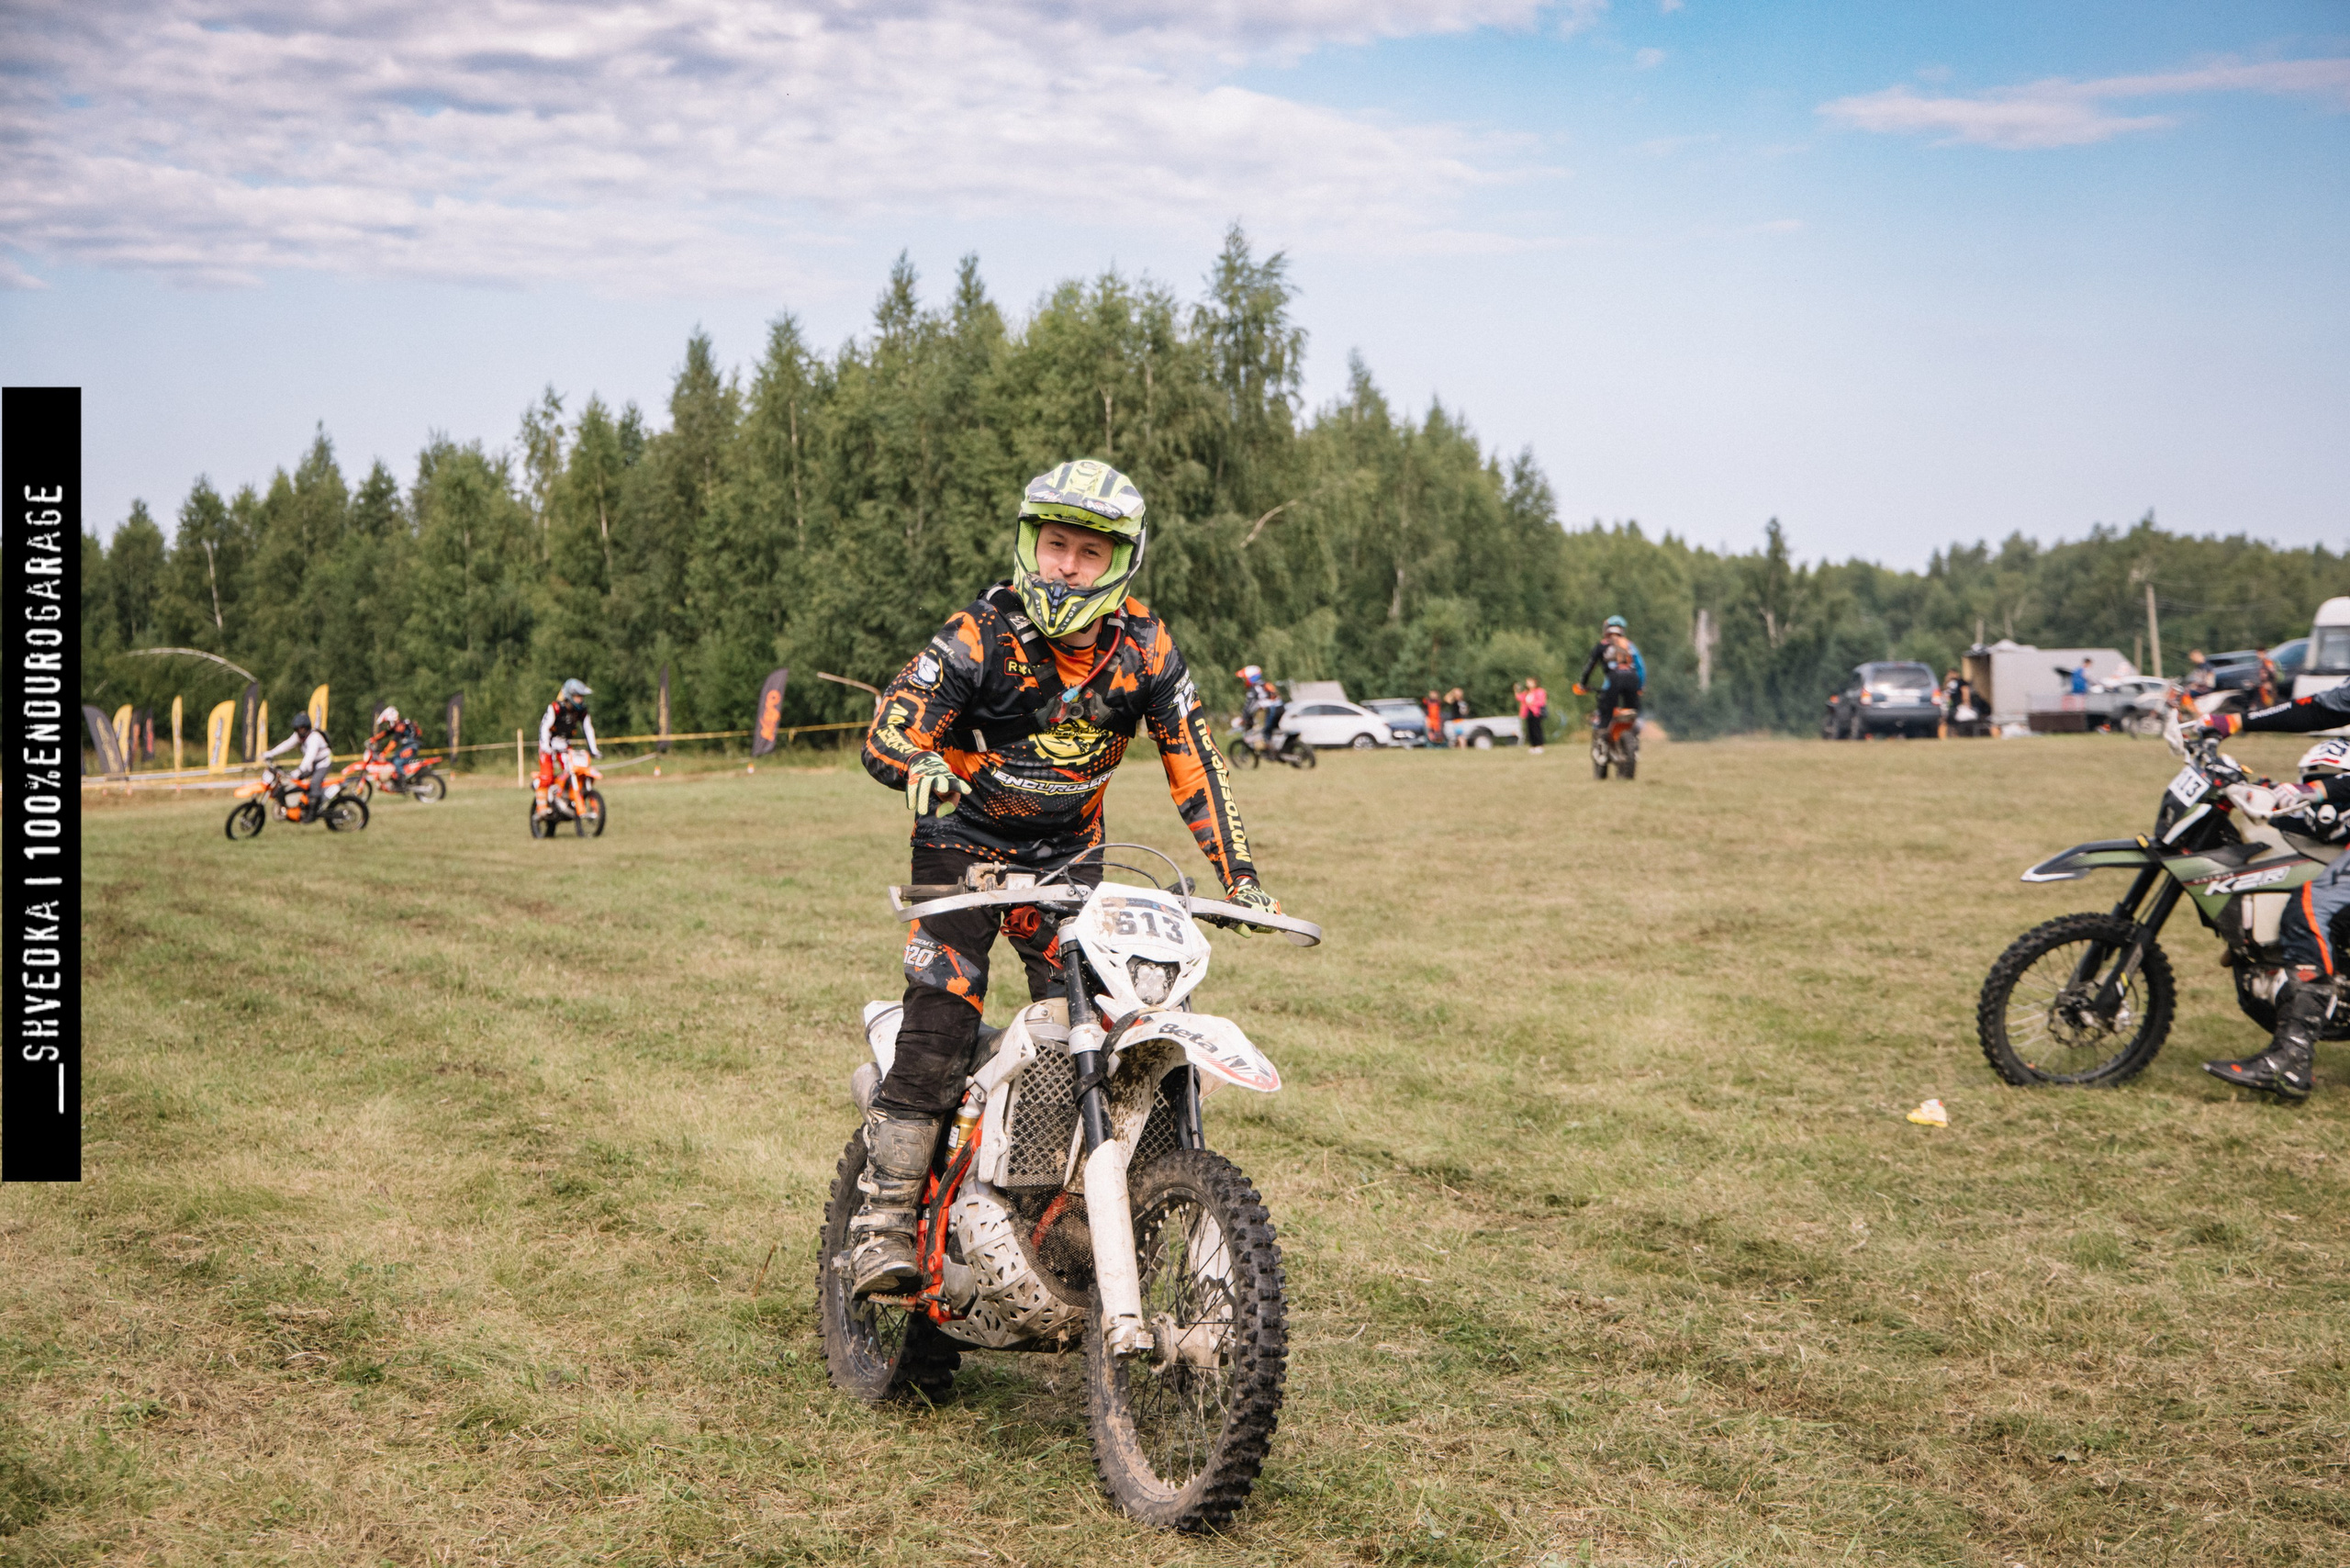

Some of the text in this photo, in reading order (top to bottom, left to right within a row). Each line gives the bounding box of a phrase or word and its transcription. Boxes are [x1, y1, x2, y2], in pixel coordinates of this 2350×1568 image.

[1114, 911, 1184, 945] 613
[903, 945, 936, 968] 120
[1158, 1023, 1219, 1053] Beta
